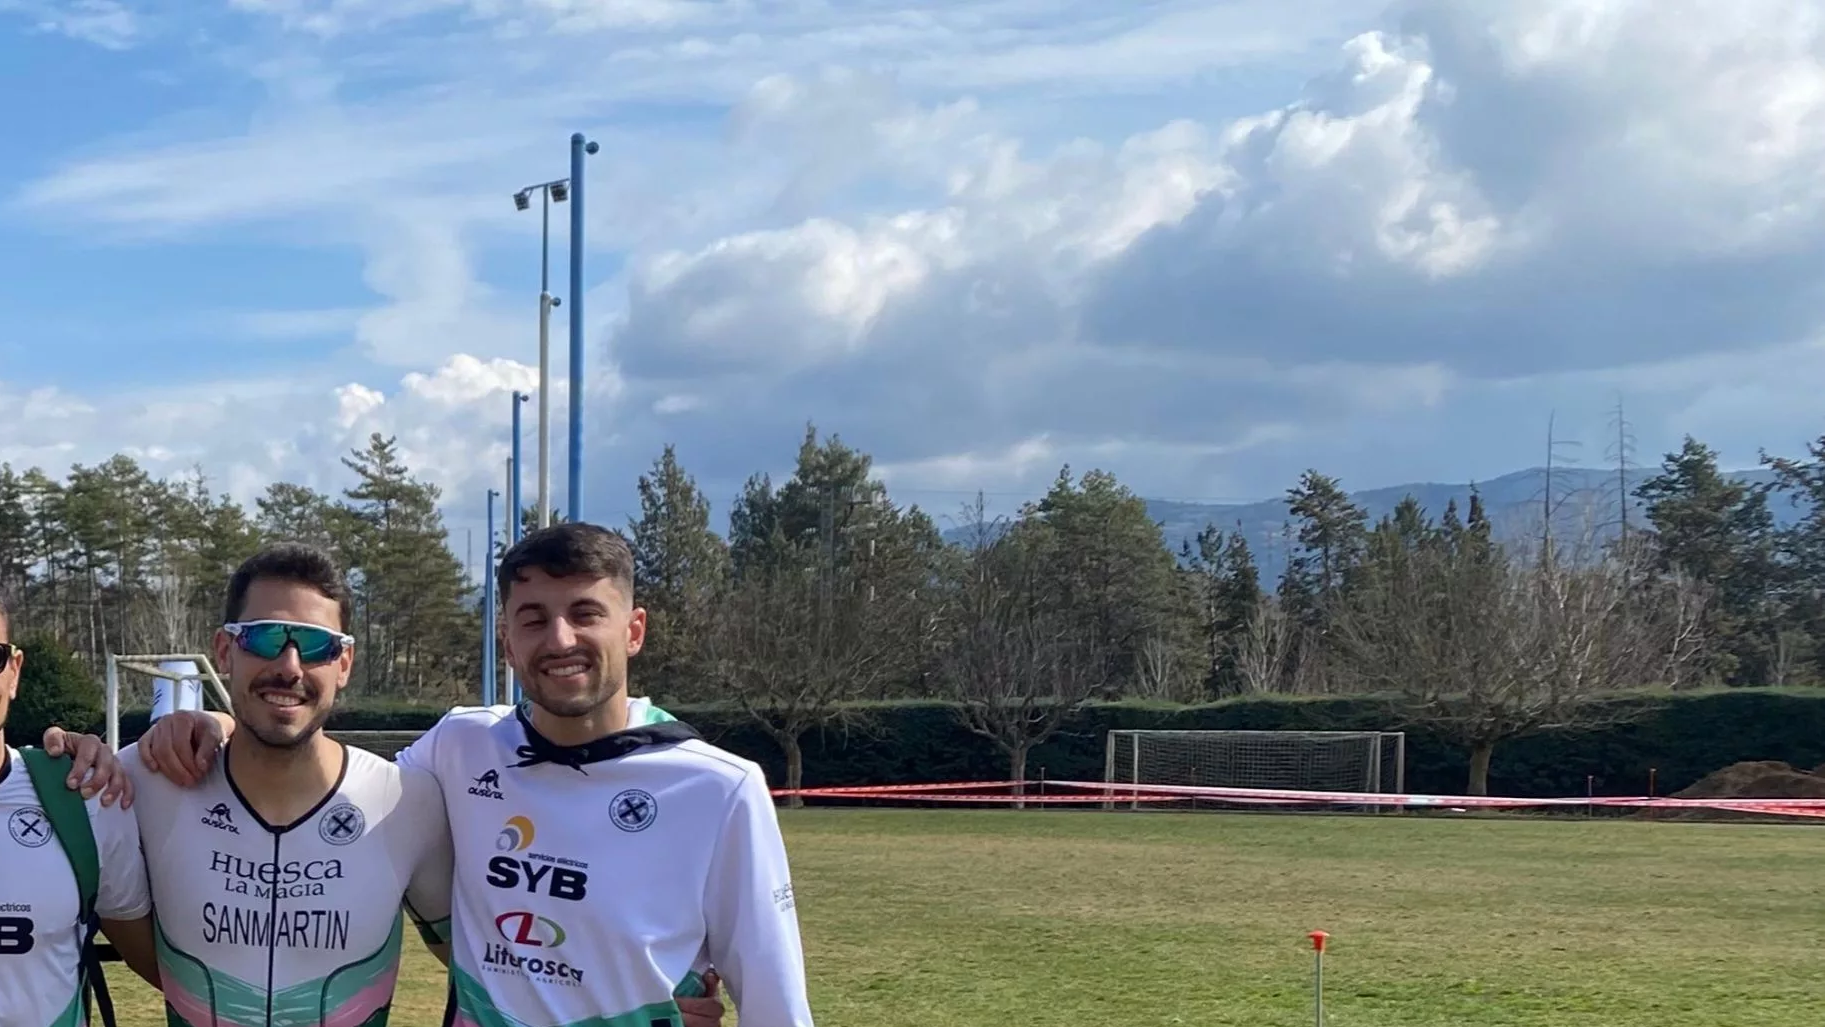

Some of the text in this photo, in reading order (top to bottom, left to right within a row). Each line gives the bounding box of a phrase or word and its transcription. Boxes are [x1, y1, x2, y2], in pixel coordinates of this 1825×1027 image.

[209, 850, 345, 885] Huesca
[225, 877, 248, 896] La
[485, 855, 589, 902] SYB
[202, 901, 350, 951] SANMARTIN
[483, 941, 585, 983] Literosca
